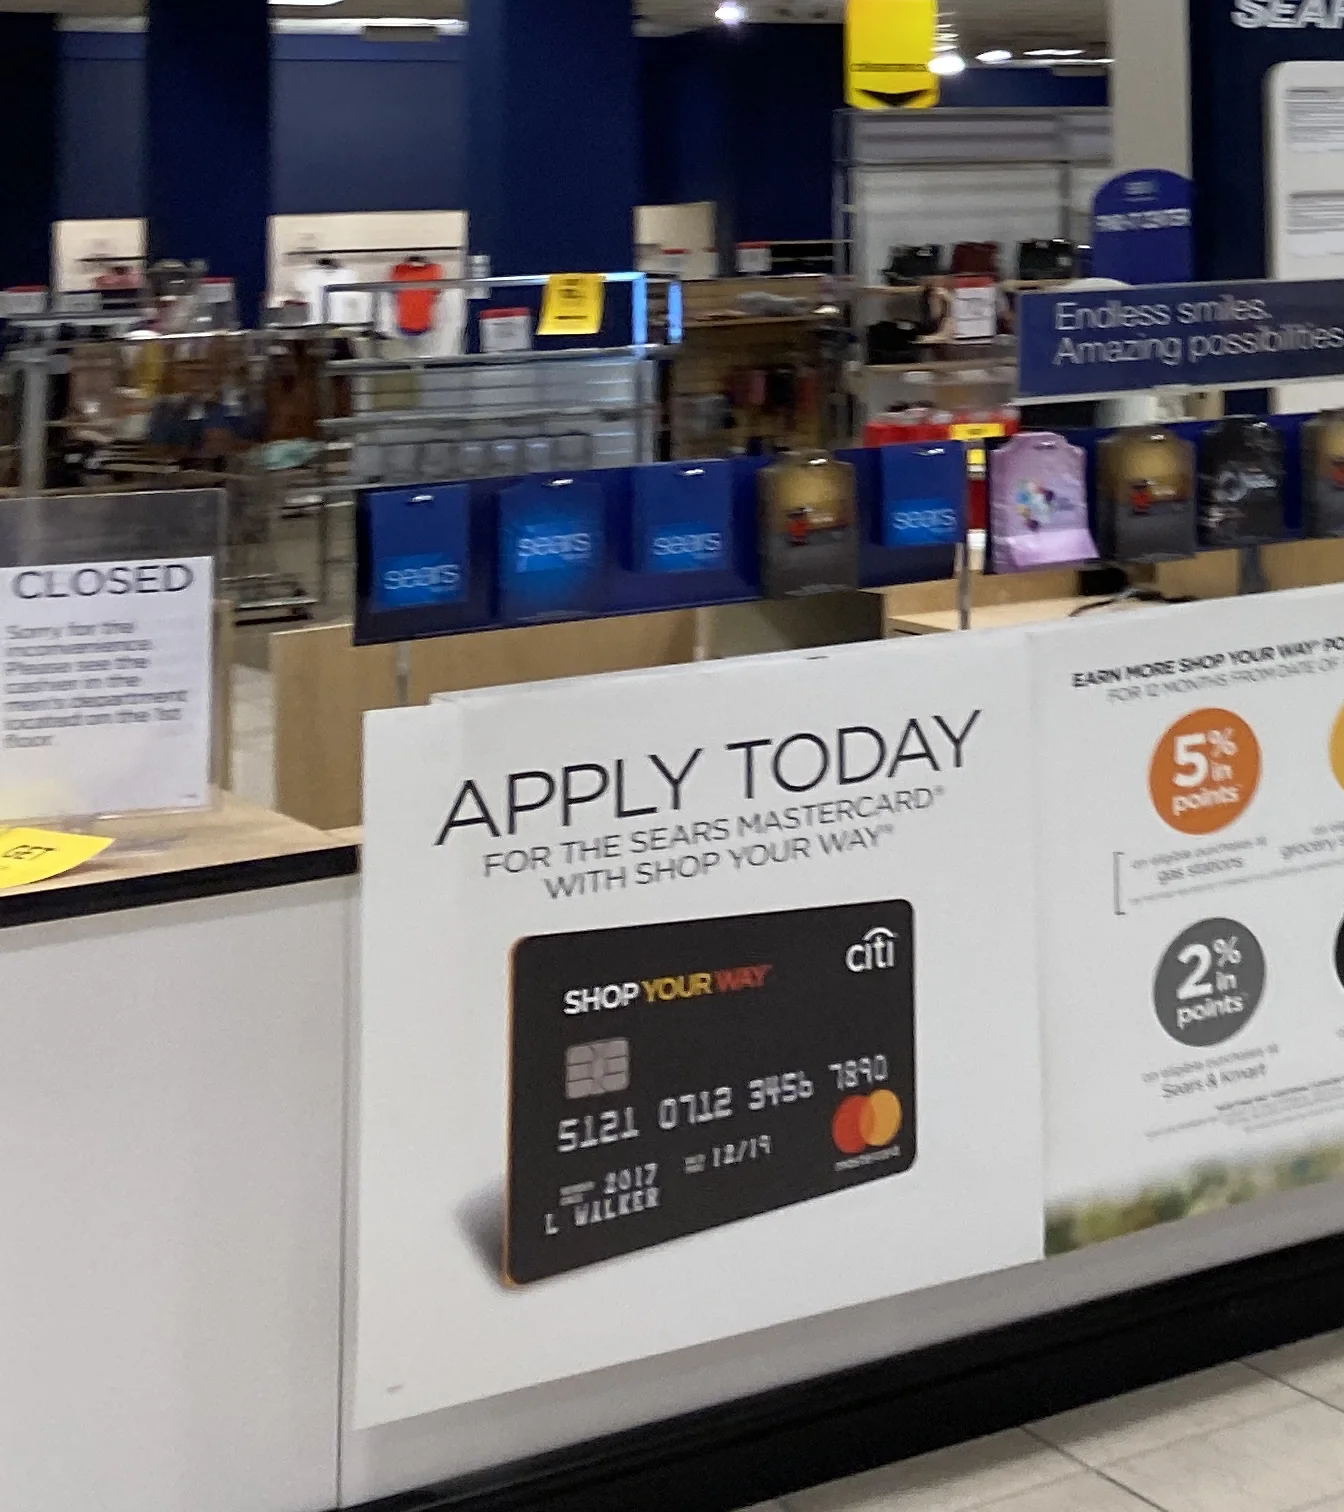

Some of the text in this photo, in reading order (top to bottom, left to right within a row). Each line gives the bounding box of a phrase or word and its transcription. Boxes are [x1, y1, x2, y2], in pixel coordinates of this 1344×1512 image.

[1055, 301, 1172, 331] Endless
[1053, 333, 1184, 366] Amazing
[517, 532, 592, 558] sears
[652, 531, 723, 557] sears
[12, 564, 195, 599] CLOSED
[1071, 667, 1122, 688] EARN
[1125, 660, 1176, 678] MORE
[1178, 653, 1225, 673] SHOP
[1227, 646, 1276, 664] YOUR
[433, 709, 983, 847] APPLY TODAY
[1173, 725, 1239, 788] 5%
[1171, 785, 1240, 817] points
[482, 845, 552, 878] FOR
[561, 834, 621, 866] THE
[630, 818, 731, 855] SEARS
[543, 869, 627, 901] WITH
[635, 852, 721, 886] SHOP
[730, 840, 812, 875] YOUR
[845, 927, 897, 973] citi
[1176, 935, 1242, 1001] 2%
[563, 964, 772, 1015] SHOP YOUR WAY
[1215, 970, 1237, 992] in
[1176, 993, 1244, 1029] points
[556, 1054, 888, 1153] 5121 0712 3456 7890
[544, 1213, 560, 1235] L
[573, 1187, 661, 1227] WALKER
